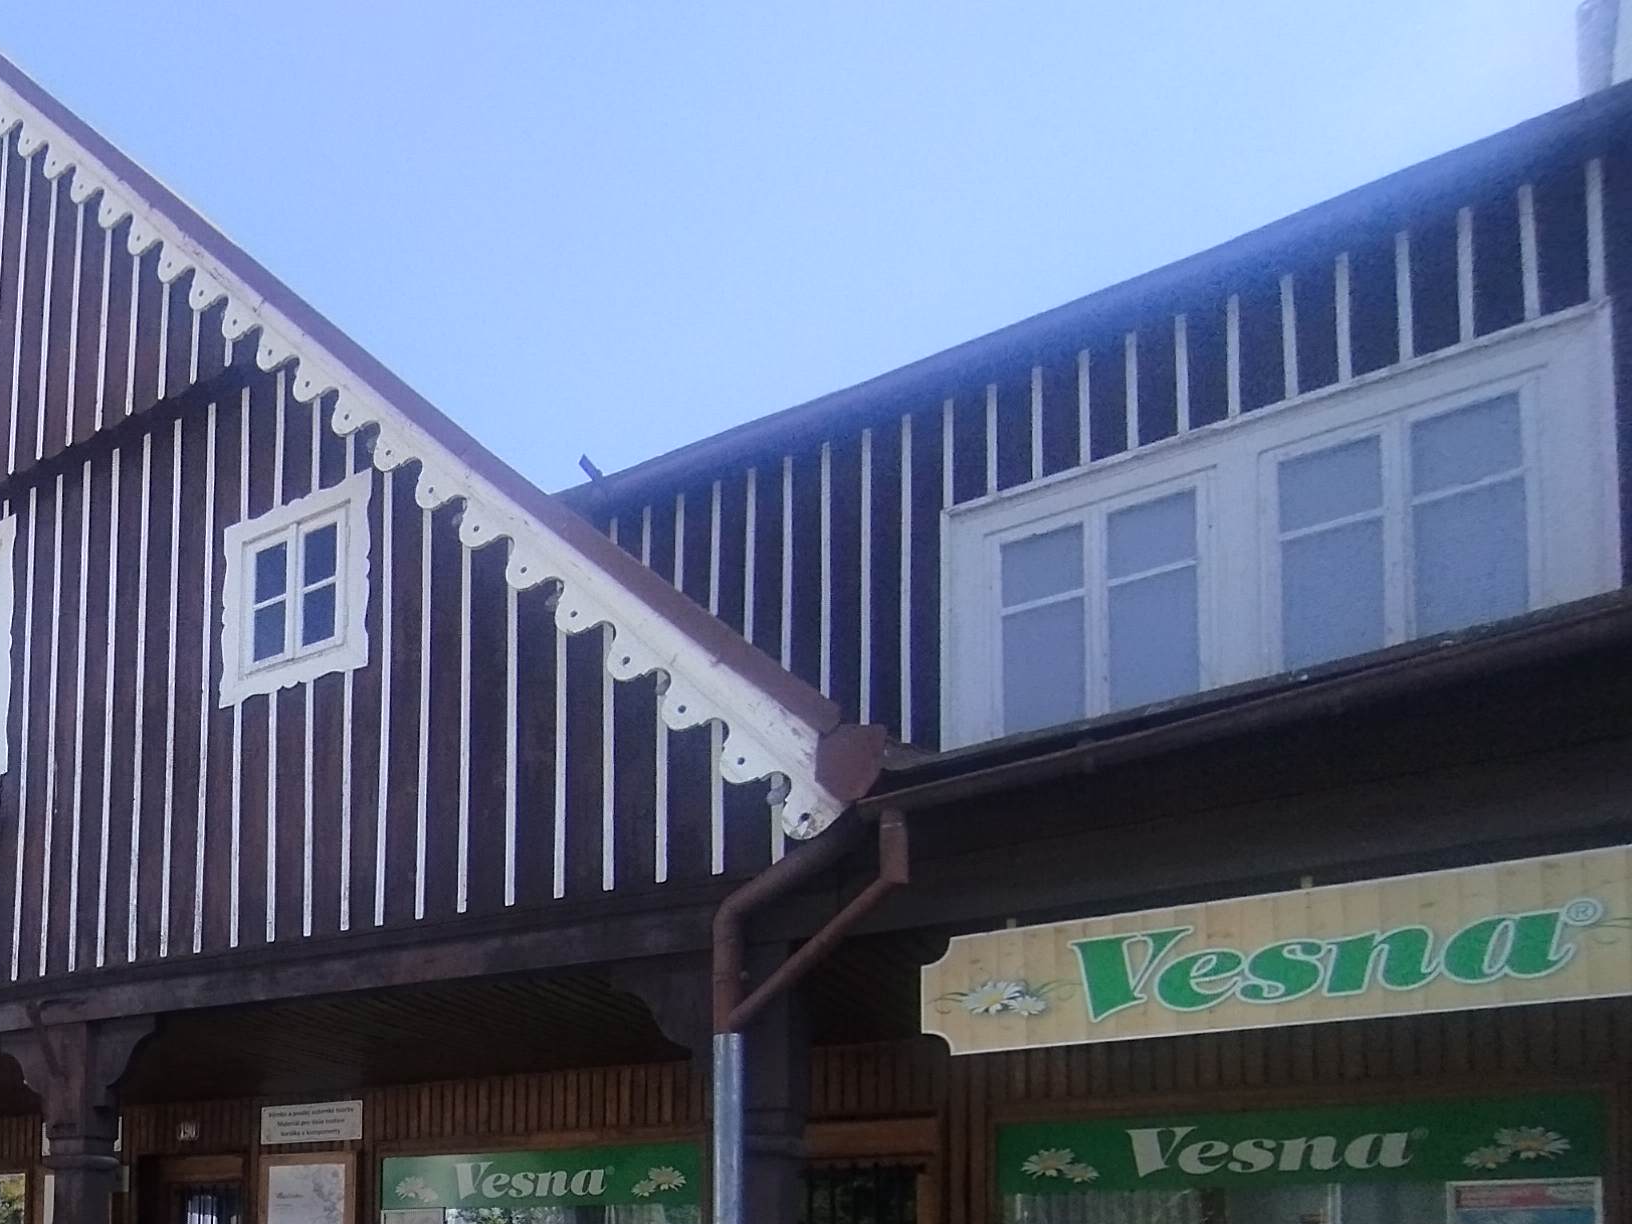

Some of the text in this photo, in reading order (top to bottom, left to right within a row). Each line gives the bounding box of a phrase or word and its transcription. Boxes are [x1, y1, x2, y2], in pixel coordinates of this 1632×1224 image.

[1070, 909, 1578, 1023] Vesna
[1125, 1126, 1415, 1178] Vesna
[454, 1161, 608, 1200] Vesna
